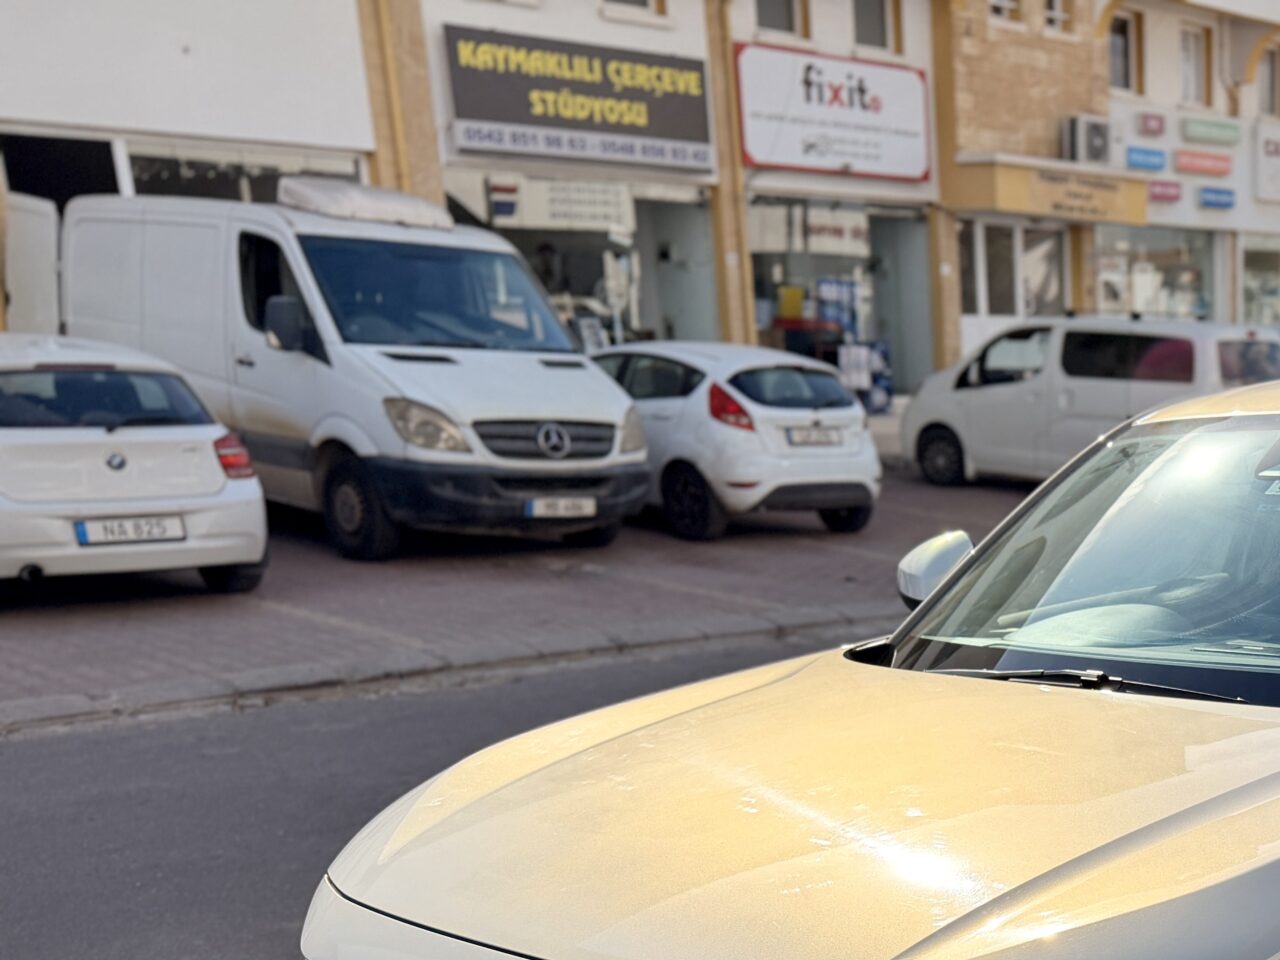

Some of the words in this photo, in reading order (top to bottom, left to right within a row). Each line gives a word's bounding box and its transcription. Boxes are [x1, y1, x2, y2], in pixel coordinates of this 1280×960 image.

[607, 60, 703, 97] ÇERÇEVE
[803, 63, 869, 111] fixit
[529, 87, 648, 127] STÜDYOSU
